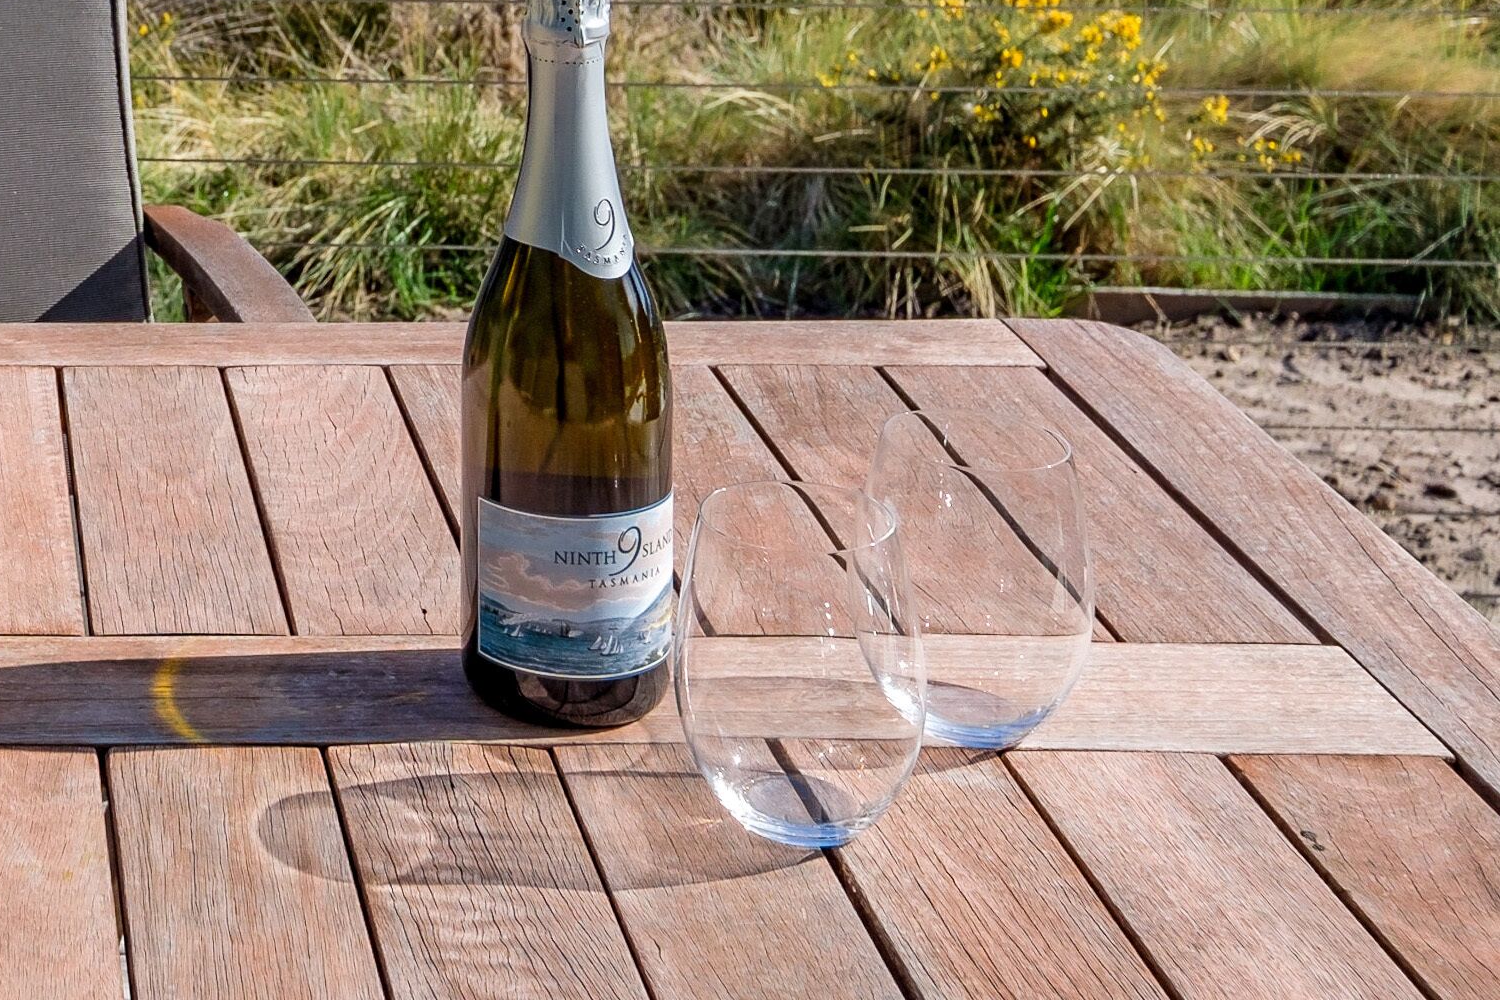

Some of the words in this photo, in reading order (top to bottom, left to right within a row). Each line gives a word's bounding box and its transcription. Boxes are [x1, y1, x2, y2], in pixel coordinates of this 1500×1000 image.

[594, 198, 616, 251] 9
[553, 550, 617, 566] NINTH
[589, 566, 660, 589] TASMANIA
